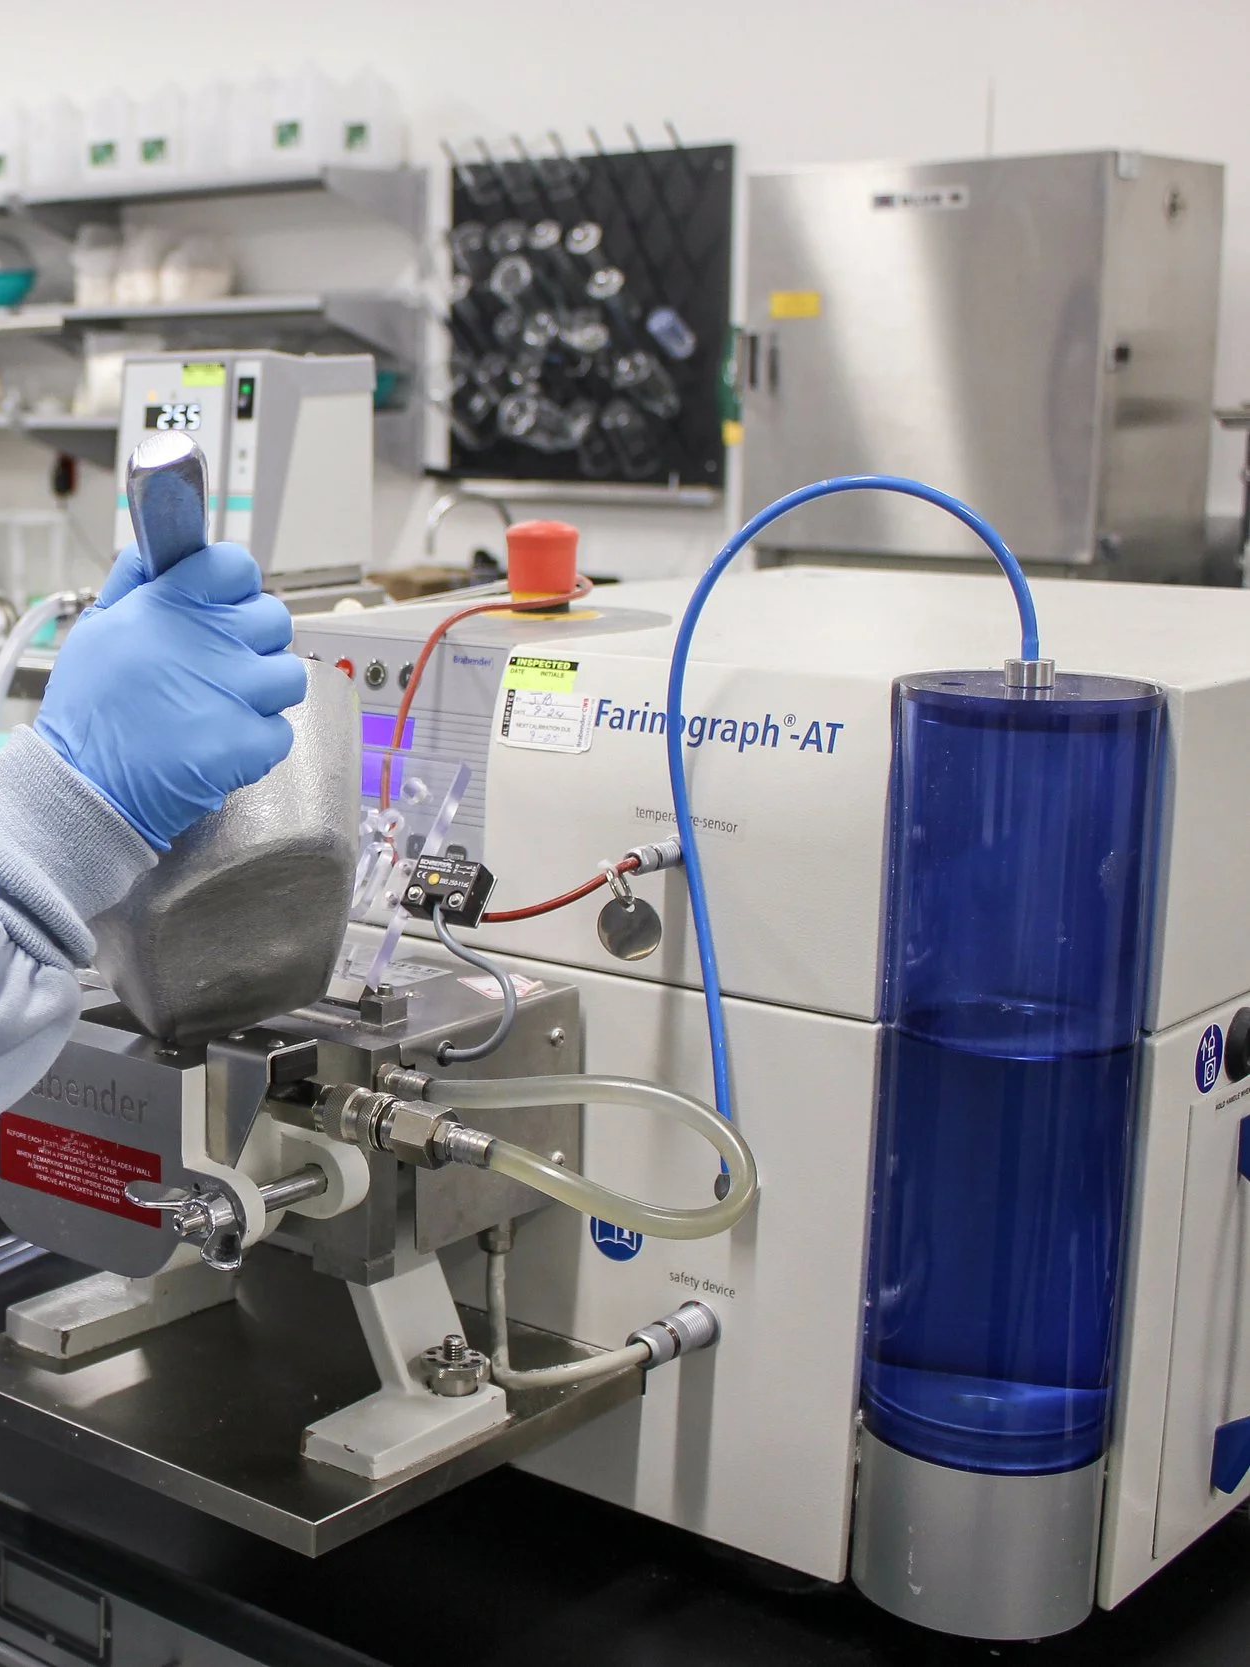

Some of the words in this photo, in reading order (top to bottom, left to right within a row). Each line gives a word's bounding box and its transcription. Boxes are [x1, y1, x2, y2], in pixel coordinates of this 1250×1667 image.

[515, 658, 571, 670] INSPECTED
[635, 806, 738, 834] temperare-sensor
[29, 1070, 148, 1125] abender
[16, 1150, 32, 1159] WHEN
[64, 1164, 83, 1175] WATER
[100, 1174, 126, 1188] CONNECT
[57, 1153, 69, 1161] FEW
[111, 1160, 133, 1171] BLADES
[136, 1166, 151, 1177] WALL
[36, 1173, 58, 1185] REMOVE
[100, 1193, 120, 1204] WATER
[82, 1178, 102, 1190] UPSIDE
[102, 1185, 120, 1195] DOWN
[669, 1271, 699, 1291] safety
[702, 1279, 736, 1299] device
